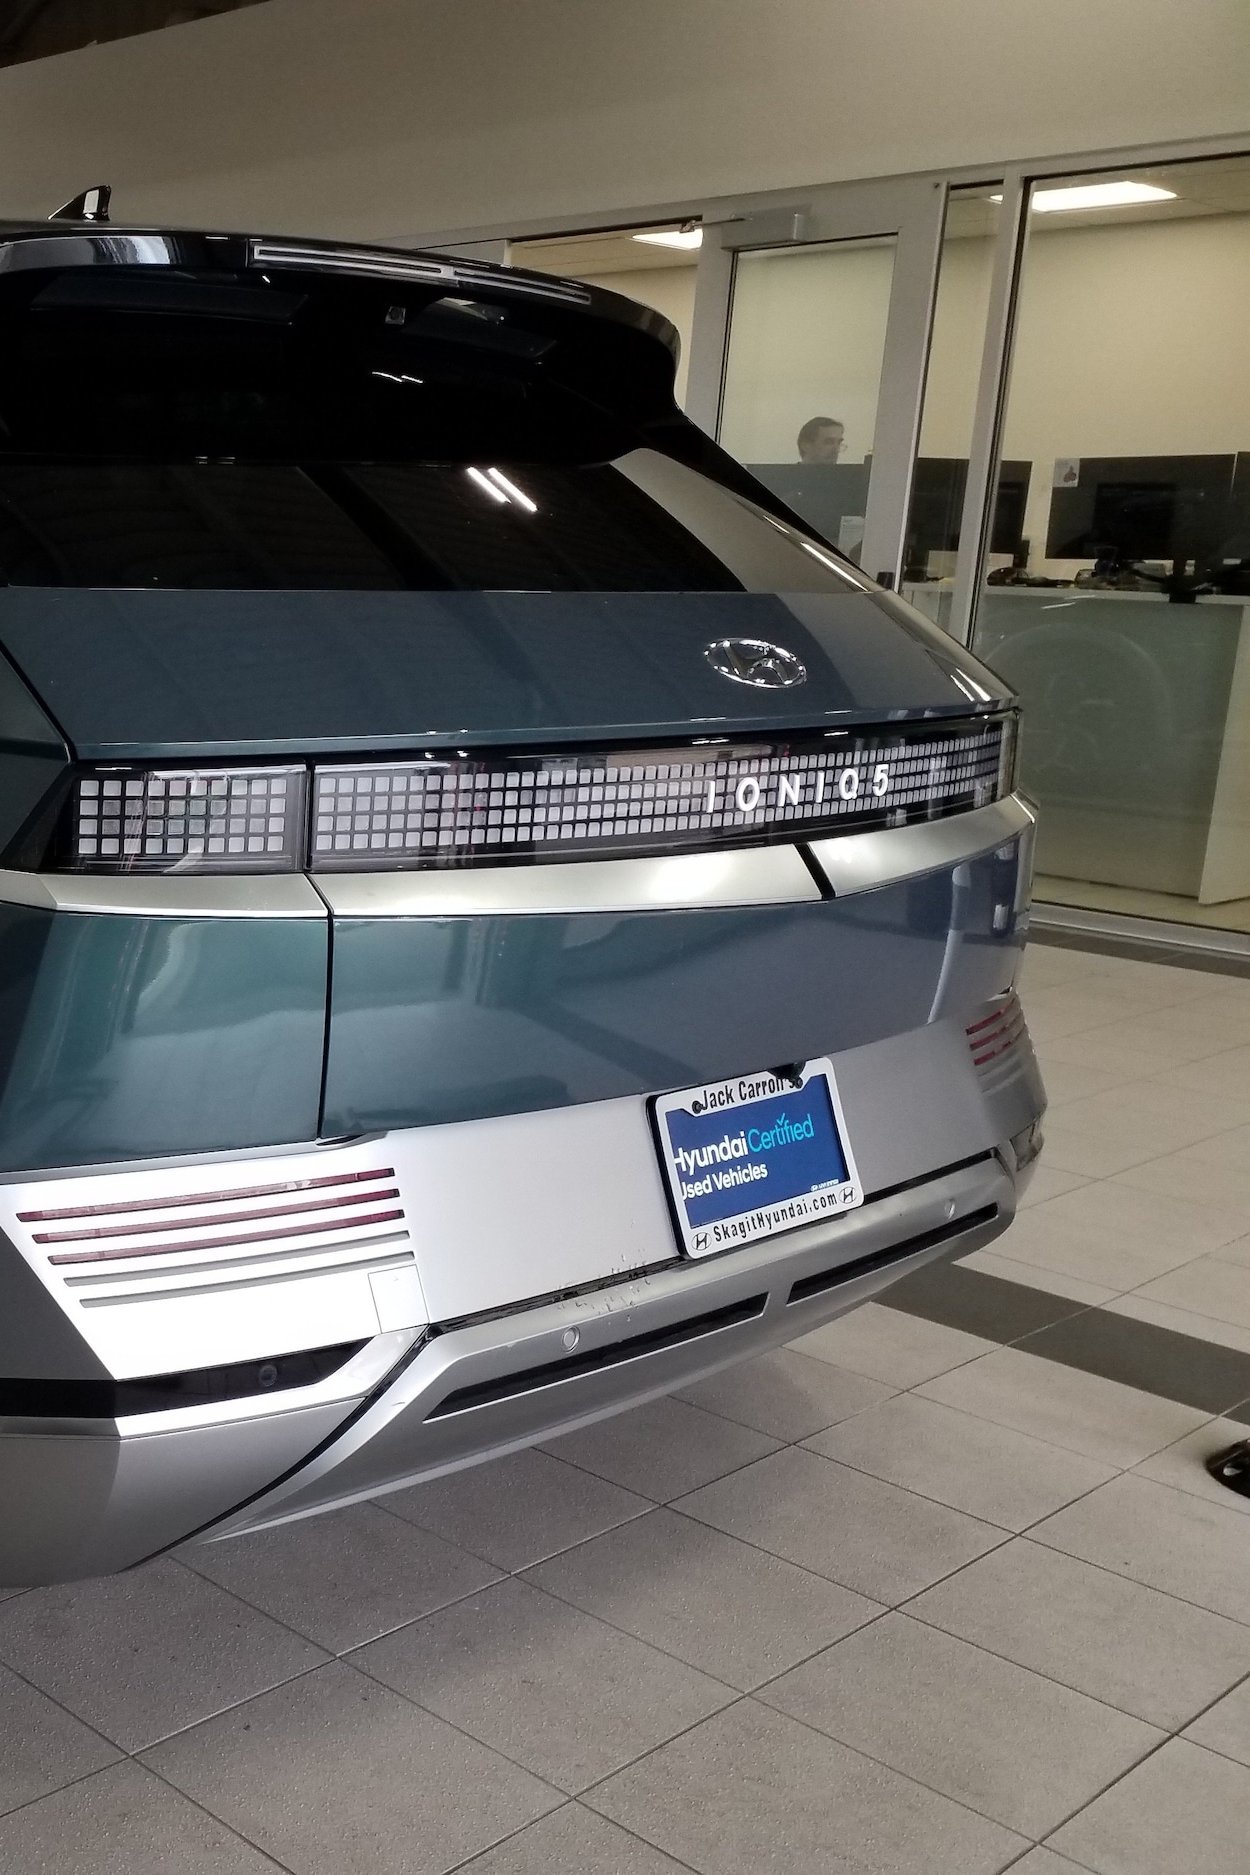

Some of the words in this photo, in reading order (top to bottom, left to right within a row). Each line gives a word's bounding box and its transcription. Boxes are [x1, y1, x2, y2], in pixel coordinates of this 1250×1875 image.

[701, 1084, 735, 1111] Jack
[673, 1130, 749, 1177] Hyundai
[747, 1112, 815, 1153] Certified
[712, 1162, 768, 1191] Vehicles
[713, 1192, 838, 1242] SkagitHyundai.com
